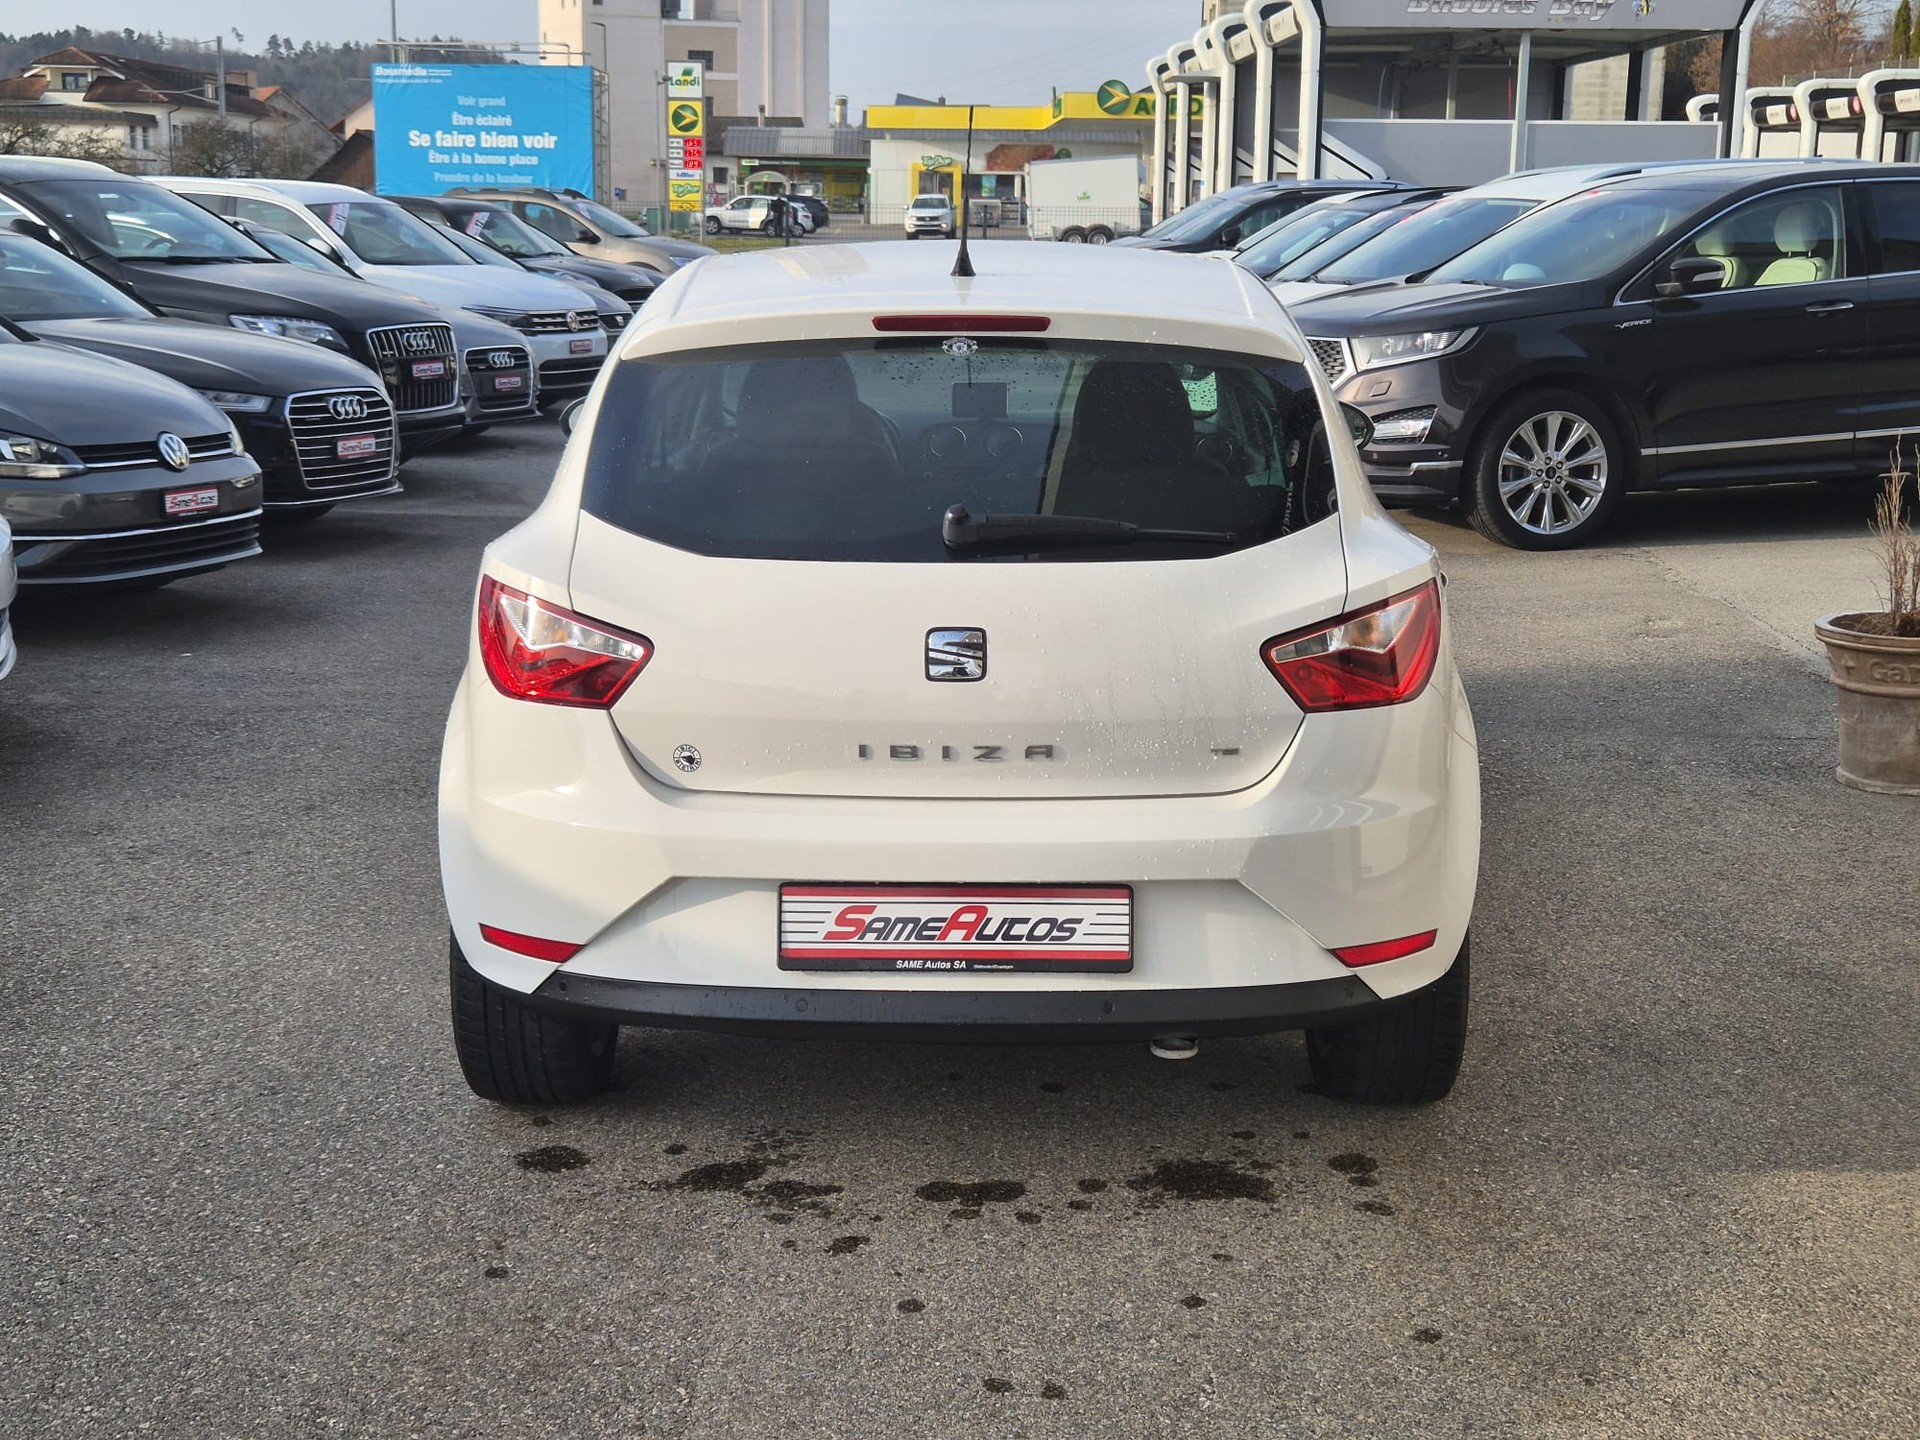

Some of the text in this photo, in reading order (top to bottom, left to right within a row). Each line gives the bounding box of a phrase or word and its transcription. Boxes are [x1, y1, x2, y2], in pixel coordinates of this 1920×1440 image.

[669, 76, 700, 87] Landi
[457, 96, 506, 108] Voir grand
[452, 112, 513, 127] Être éclairé
[408, 130, 558, 150] Se faire bien voir
[428, 150, 538, 168] Être à la bonne place
[434, 171, 470, 183] Prendre
[472, 172, 485, 184] de
[858, 744, 1054, 761] IBIZA
[896, 960, 923, 969] SAME
[924, 960, 951, 969] Autos
[953, 960, 967, 969] SA
